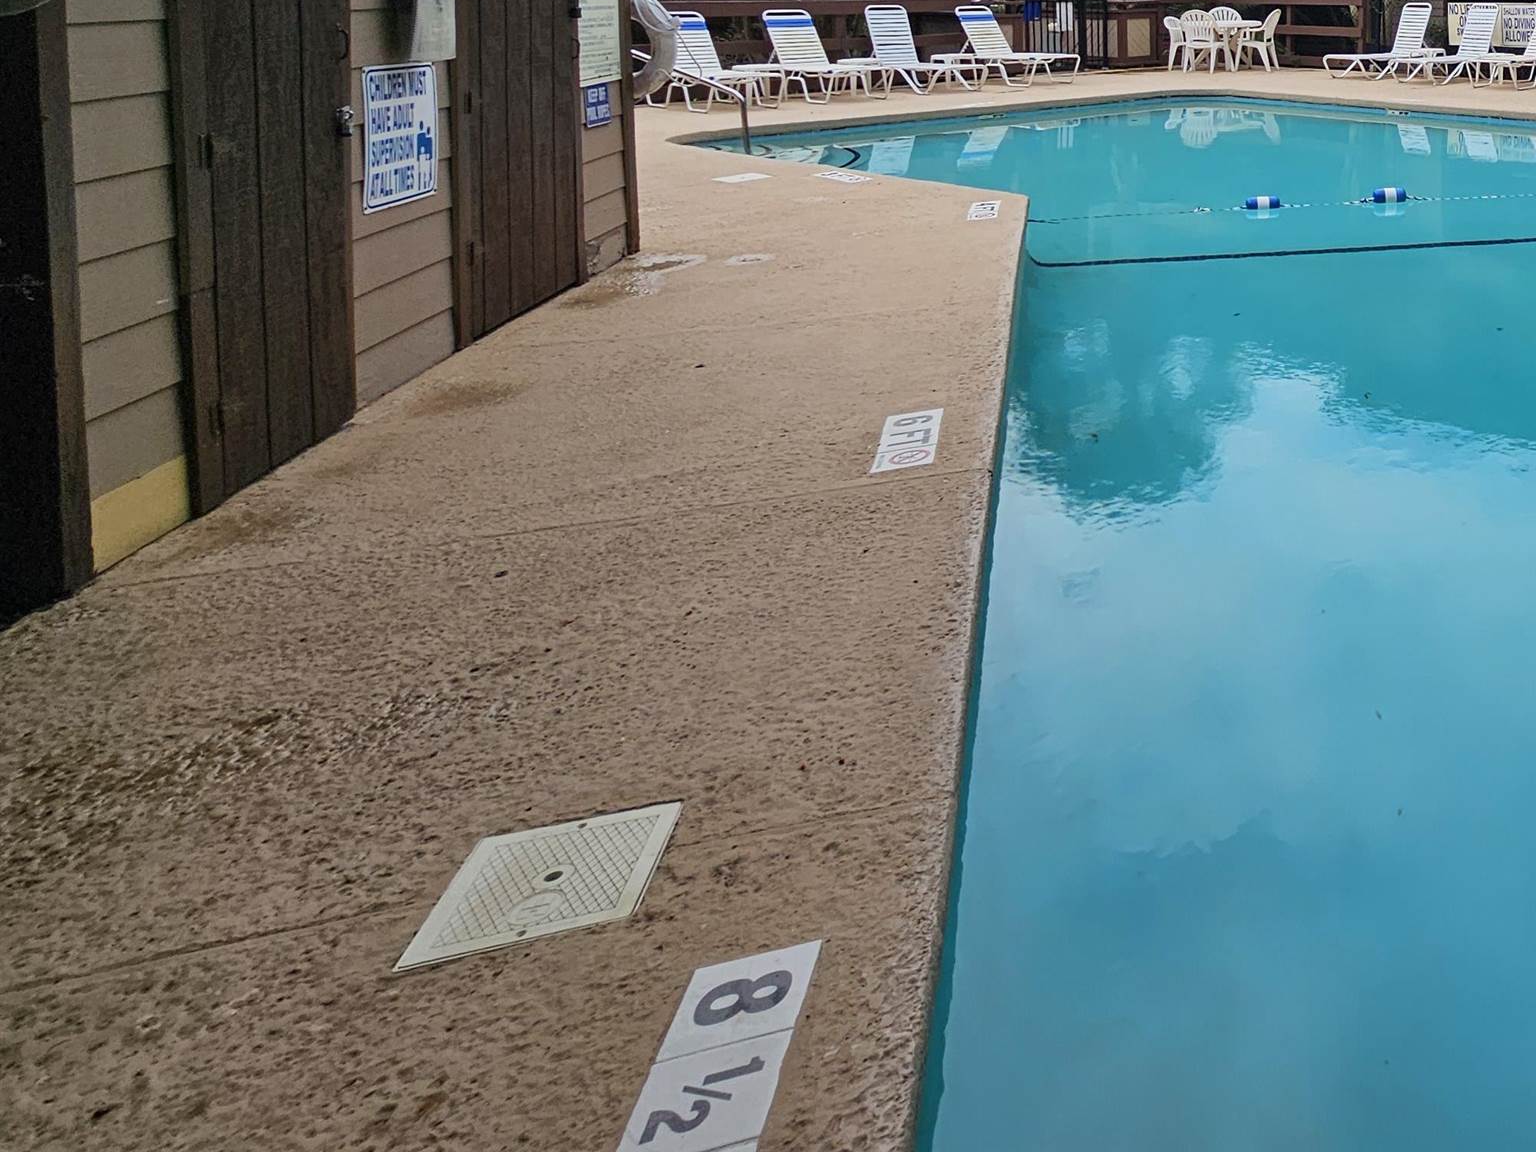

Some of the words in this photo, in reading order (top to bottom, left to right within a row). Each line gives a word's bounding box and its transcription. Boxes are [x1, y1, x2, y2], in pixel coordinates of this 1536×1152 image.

[1448, 4, 1459, 15] NO
[1503, 7, 1520, 16] SHALLOW
[1521, 7, 1535, 16] WATER
[1503, 17, 1512, 29] NO
[1514, 17, 1535, 29] DIVING
[369, 72, 407, 102] CHILDREN
[408, 70, 426, 97] MUST
[371, 106, 391, 135] HAVE
[393, 103, 414, 130] ADULT
[371, 134, 414, 167] SUPERVISION
[369, 172, 380, 200] AT
[379, 170, 393, 197] ALL
[394, 165, 414, 194] TIMES
[893, 414, 933, 427] 6
[886, 428, 932, 447] FT
[692, 969, 793, 1027] 8
